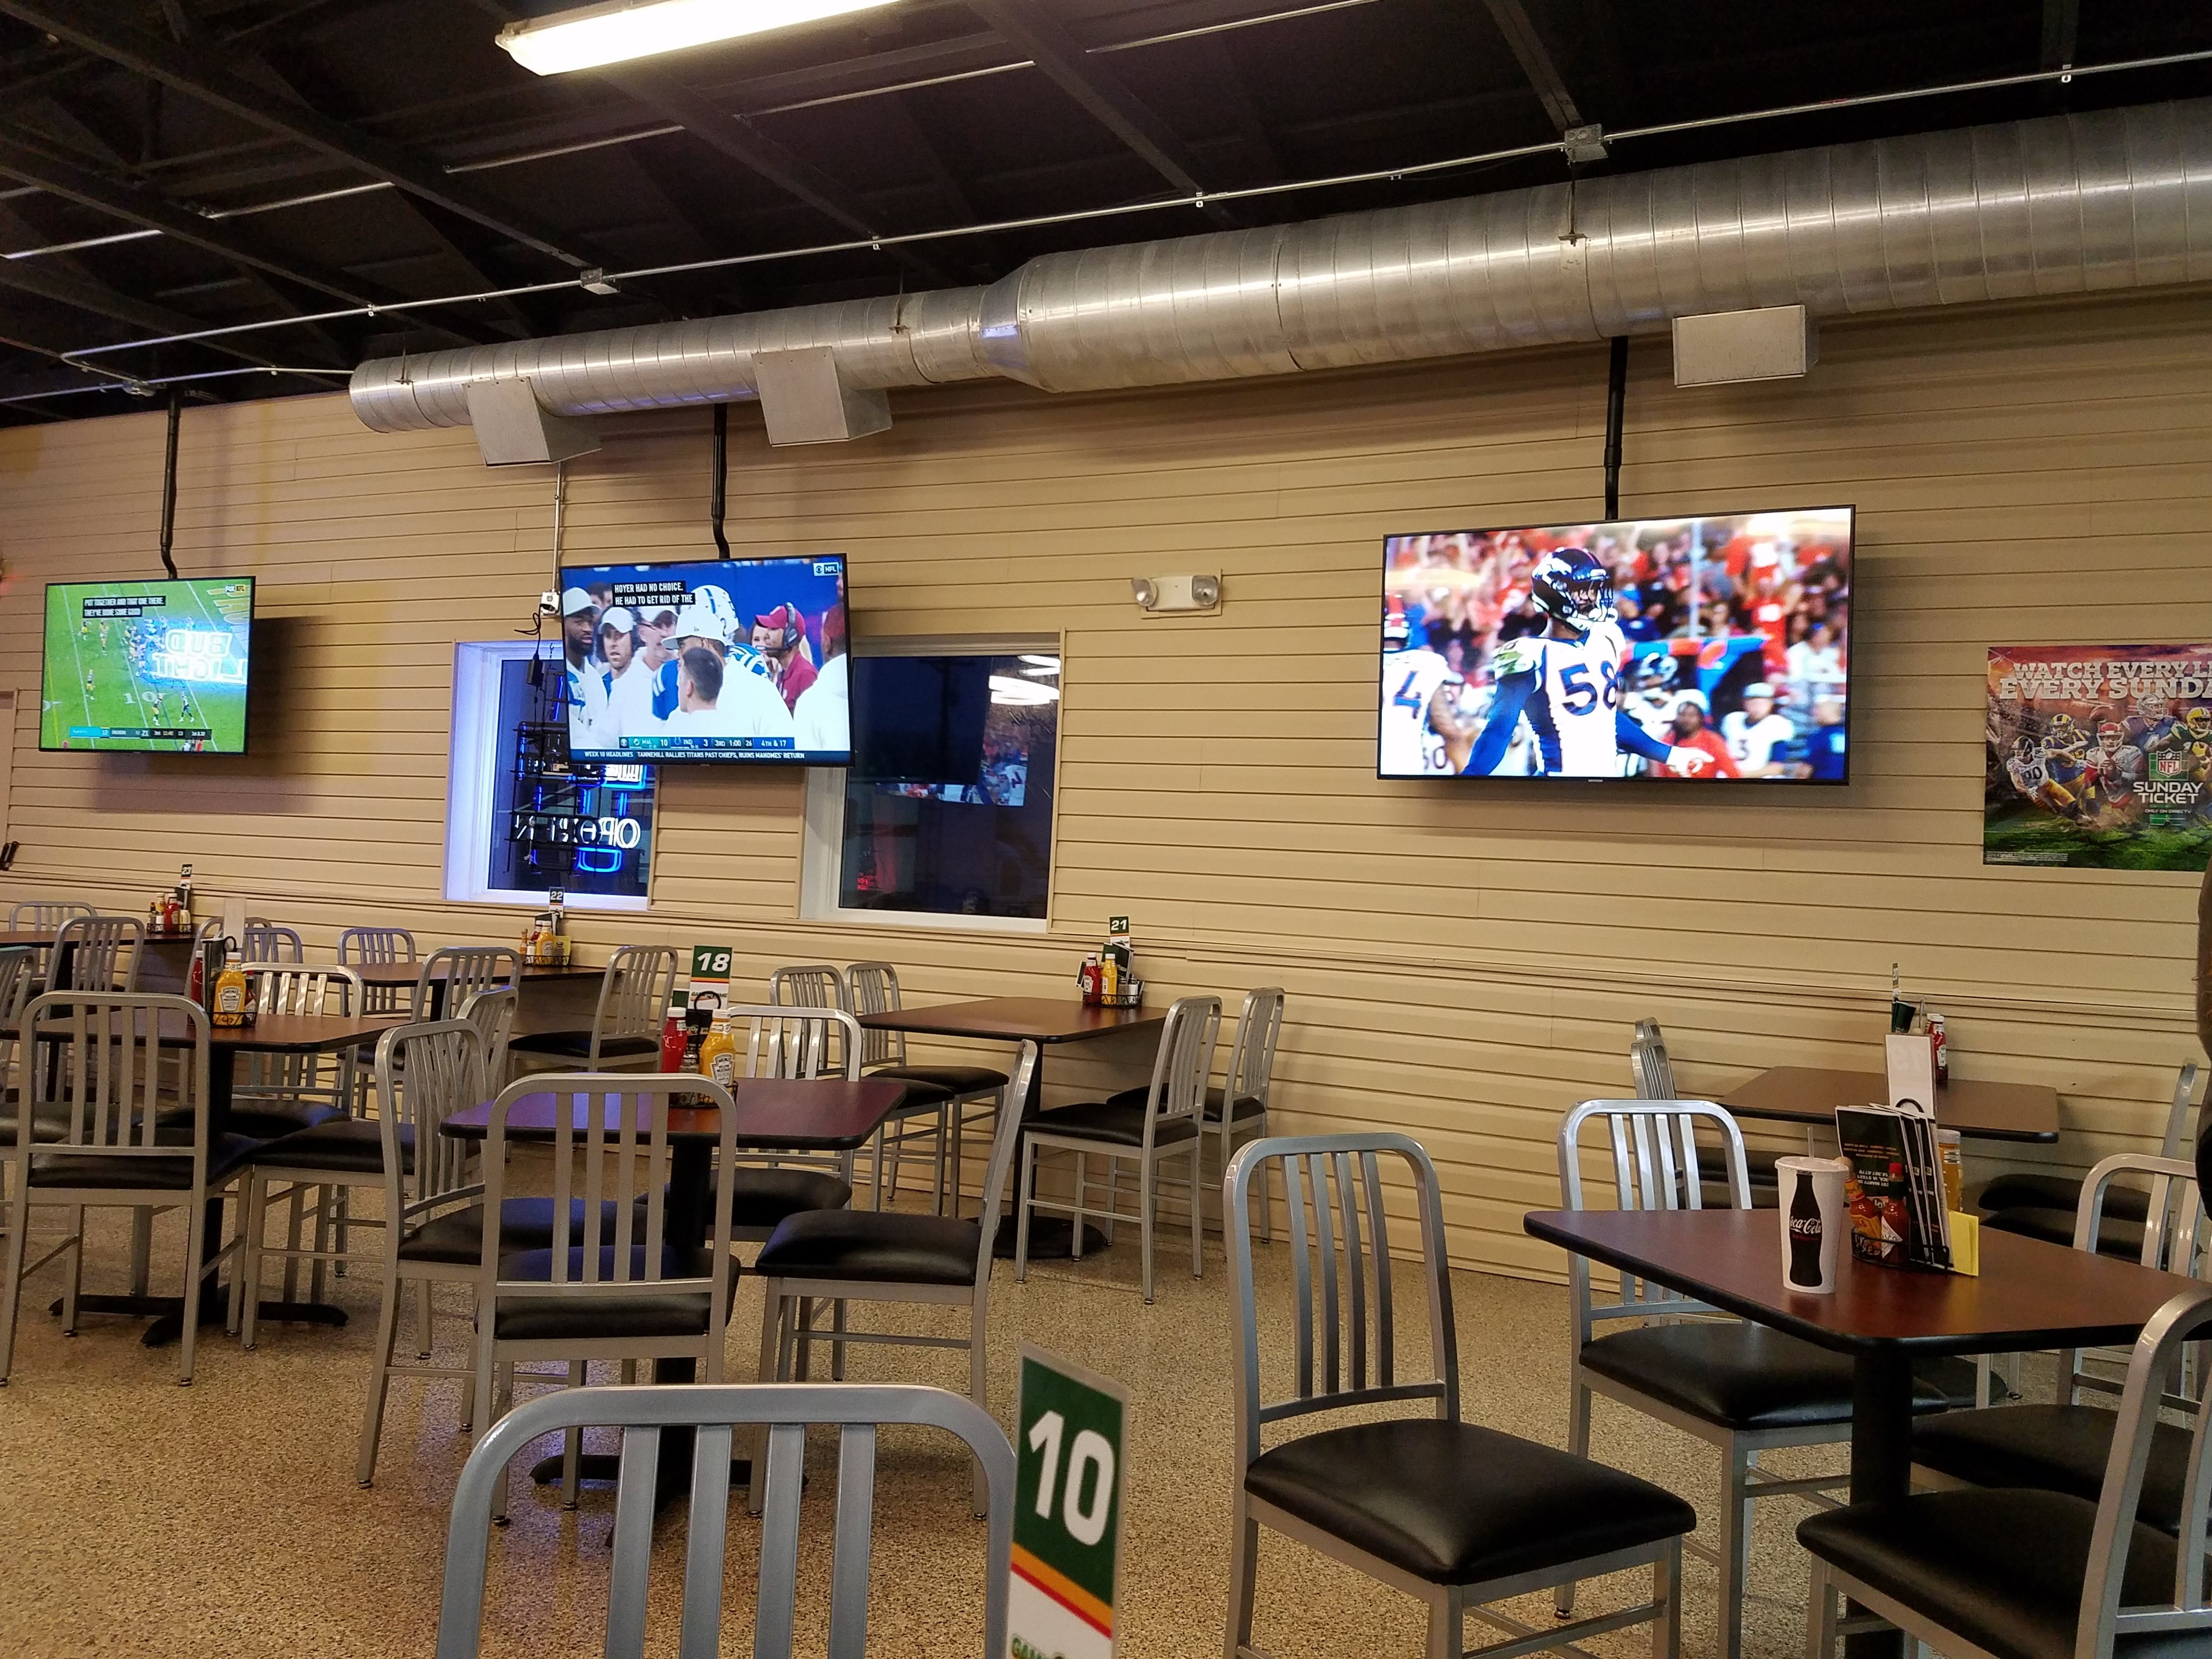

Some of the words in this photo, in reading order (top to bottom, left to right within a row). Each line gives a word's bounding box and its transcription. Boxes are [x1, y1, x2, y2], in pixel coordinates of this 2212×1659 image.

[614, 584, 634, 593] HOYER
[635, 583, 647, 592] HAD
[648, 583, 658, 592] NO
[658, 582, 684, 591] CHOICE.
[615, 596, 623, 605] HE
[624, 596, 636, 605] HAD
[637, 596, 645, 605] TO
[647, 595, 658, 605] GET
[659, 595, 670, 604] RID
[672, 594, 680, 603] OF
[681, 594, 693, 603] THE
[2013, 663, 2102, 679] WATCH
[2107, 661, 2188, 678] EVERY
[1559, 660, 1618, 716] 58
[2000, 678, 2103, 699] EVERY
[2160, 761, 2179, 773] NFL
[2133, 782, 2204, 793] SUNDAY
[2137, 793, 2199, 804] TICKET
[550, 891, 563, 900] 22
[1111, 919, 1127, 931] 21
[697, 952, 730, 972] 18
[1028, 1410, 1115, 1546] 10
